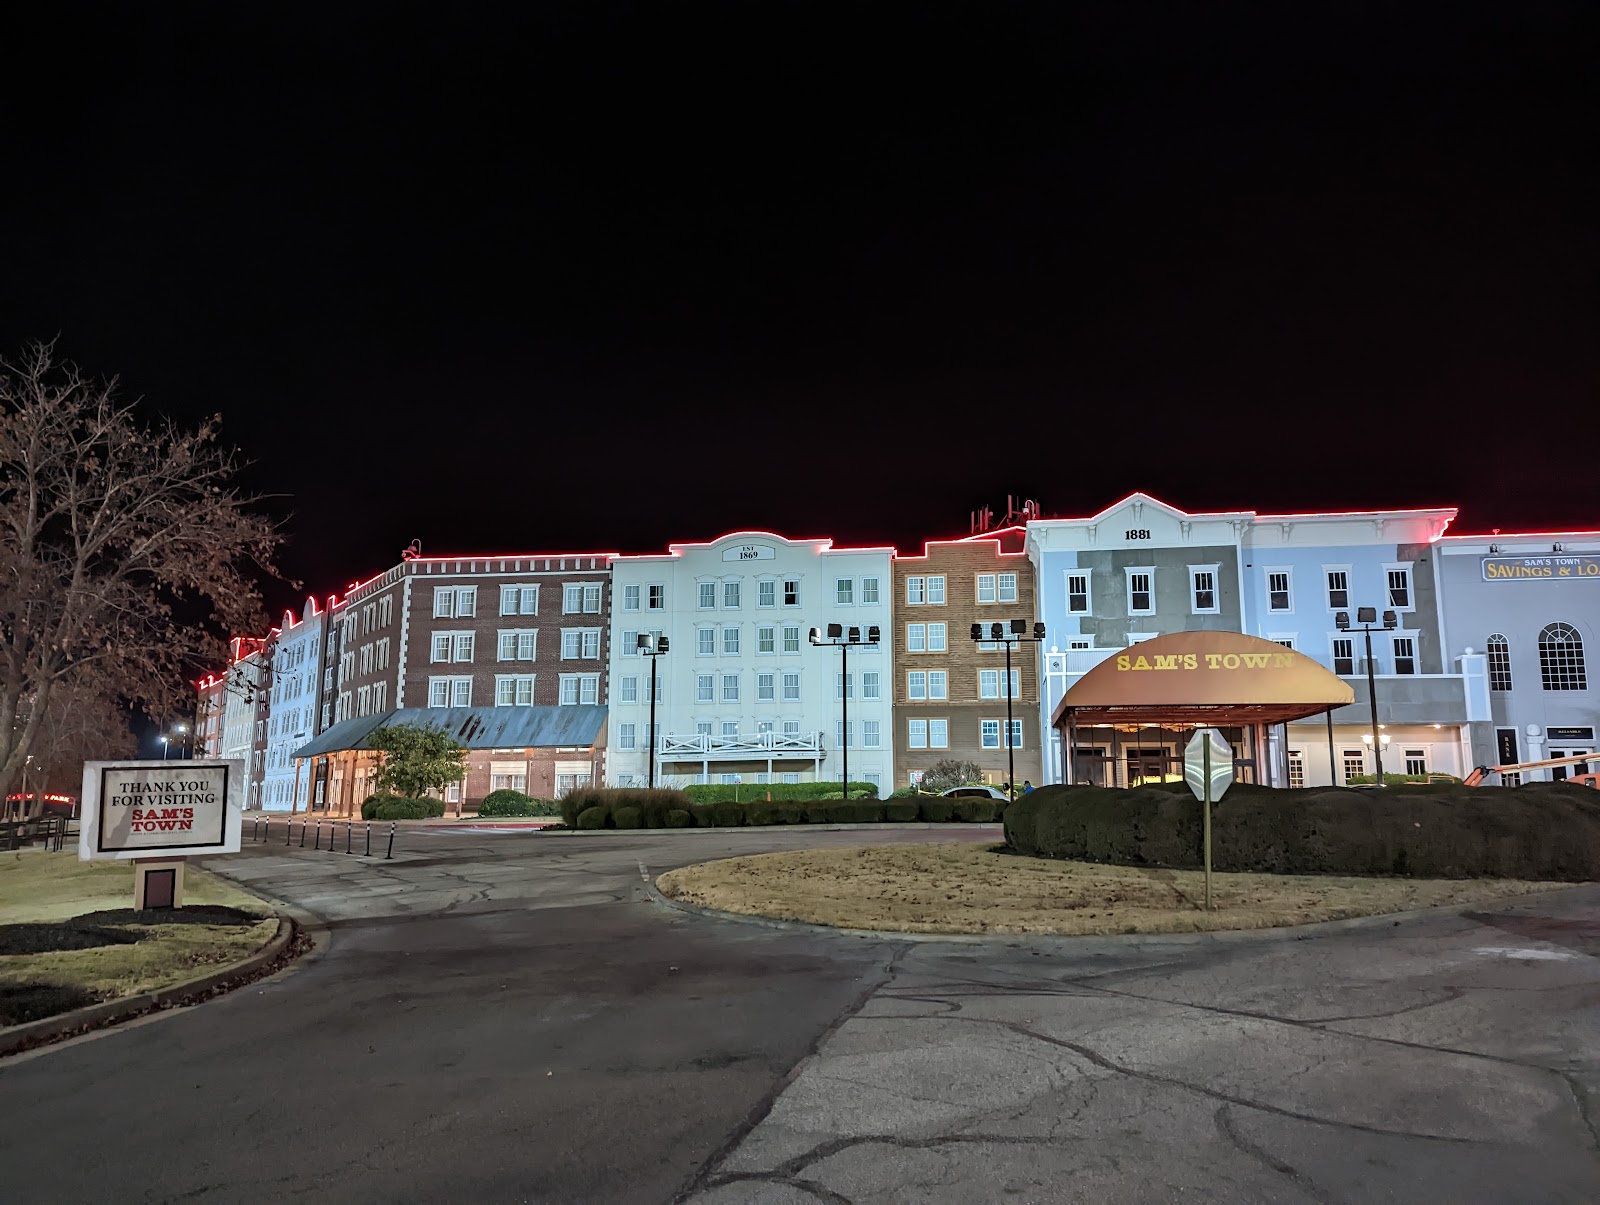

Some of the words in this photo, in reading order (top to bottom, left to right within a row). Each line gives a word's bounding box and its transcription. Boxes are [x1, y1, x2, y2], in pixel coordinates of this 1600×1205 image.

[1125, 529, 1151, 540] 1881
[740, 551, 758, 559] 1869
[1487, 563, 1552, 578] SAVINGS
[1558, 567, 1571, 577] &
[1577, 563, 1600, 576] LO
[1116, 653, 1199, 671] SAM'S
[1205, 653, 1295, 670] TOWN
[120, 782, 175, 793] THANK
[179, 781, 209, 791] YOU
[112, 796, 144, 806] FOR
[147, 793, 215, 805] VISITING
[132, 808, 194, 820] SAM'S
[131, 820, 194, 832] TOWN
